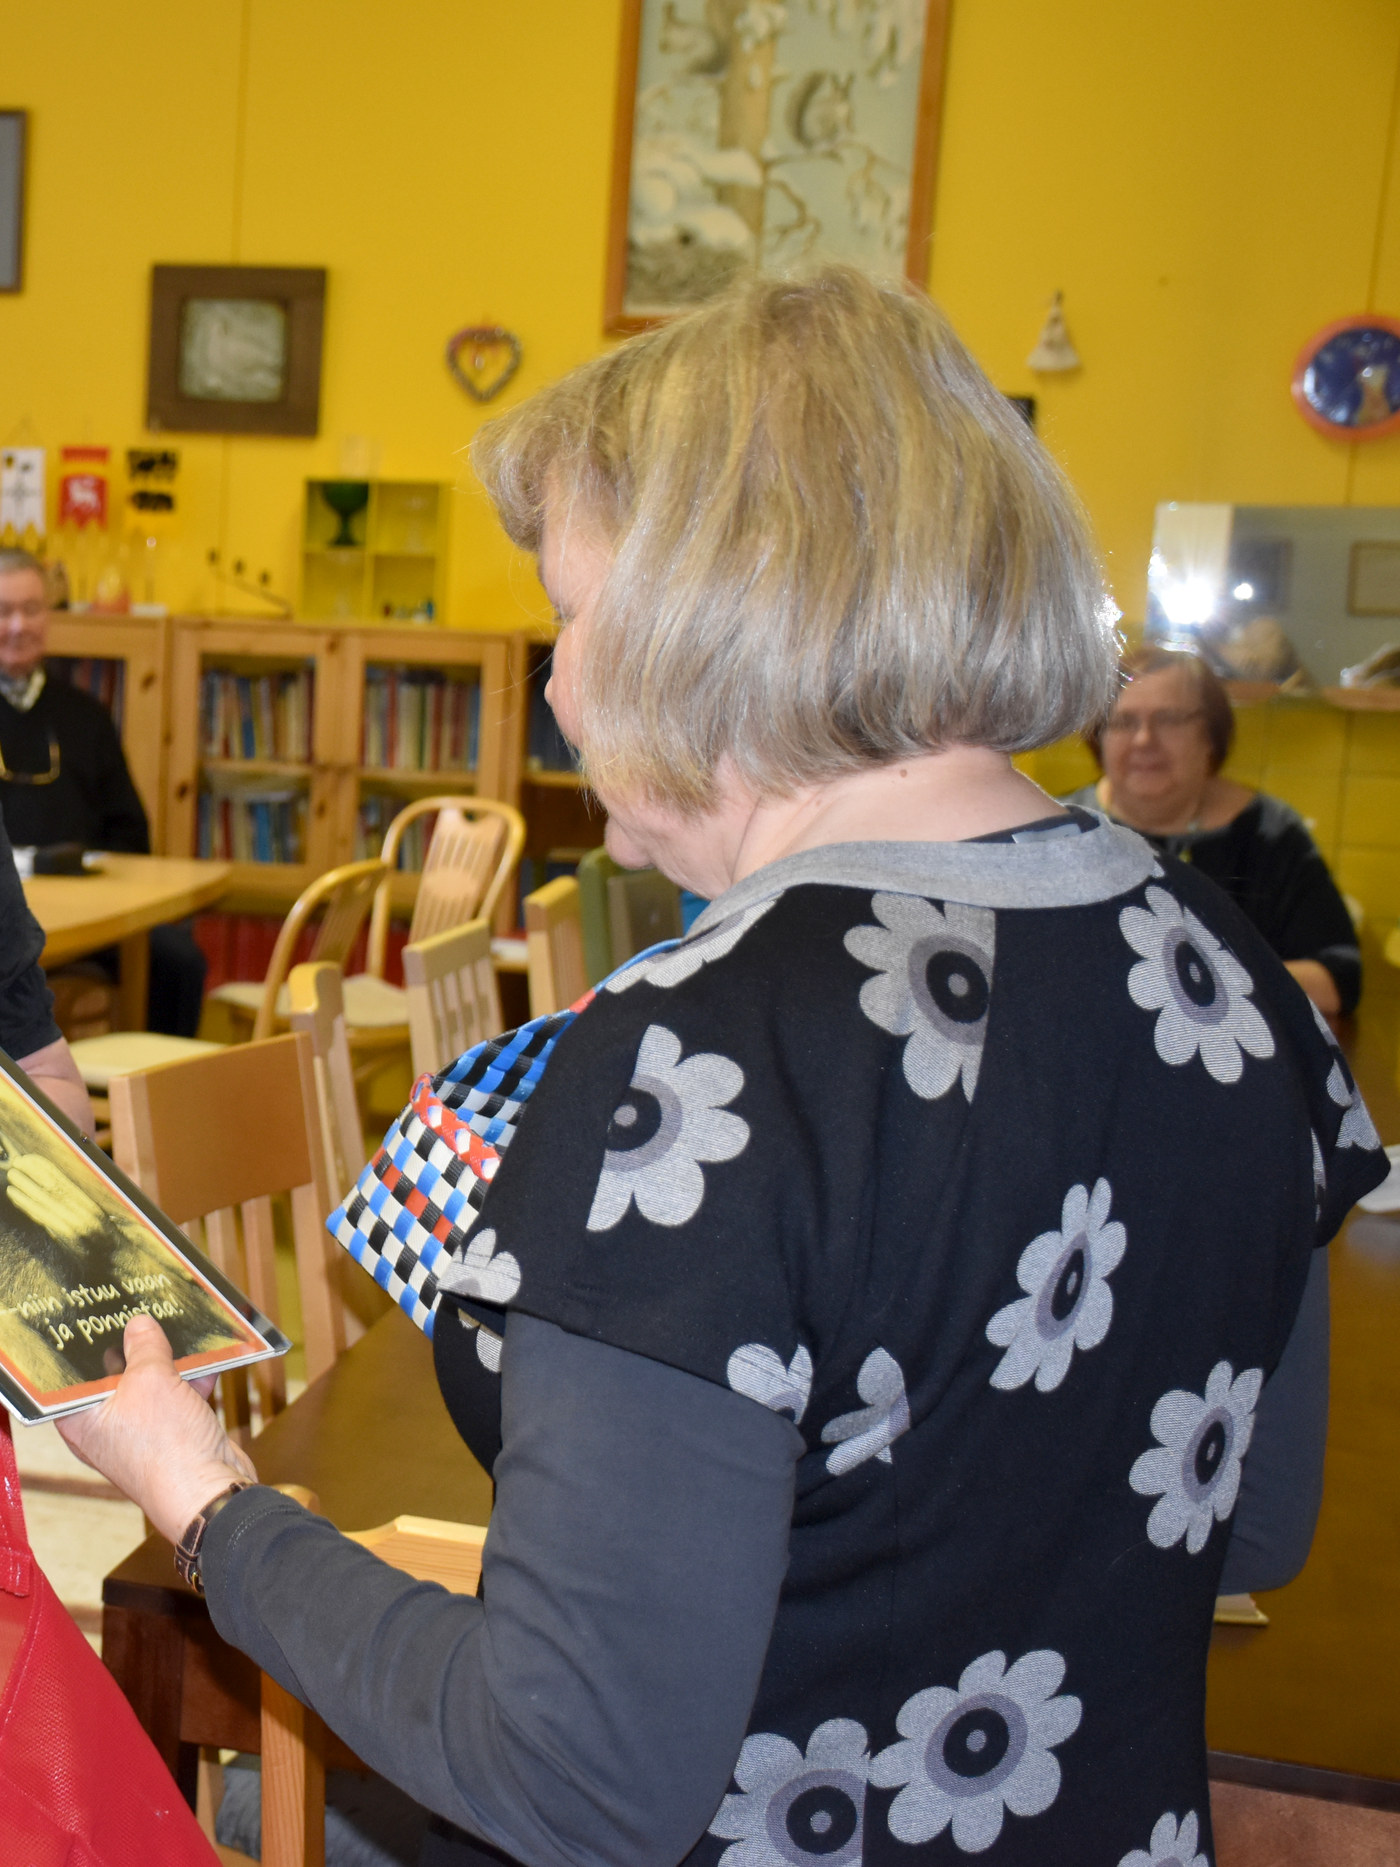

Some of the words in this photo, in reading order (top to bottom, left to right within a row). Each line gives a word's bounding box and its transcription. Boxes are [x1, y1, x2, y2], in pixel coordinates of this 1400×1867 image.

[62, 1282, 120, 1308] istuu
[121, 1272, 172, 1296] vaan
[45, 1317, 75, 1351] ja
